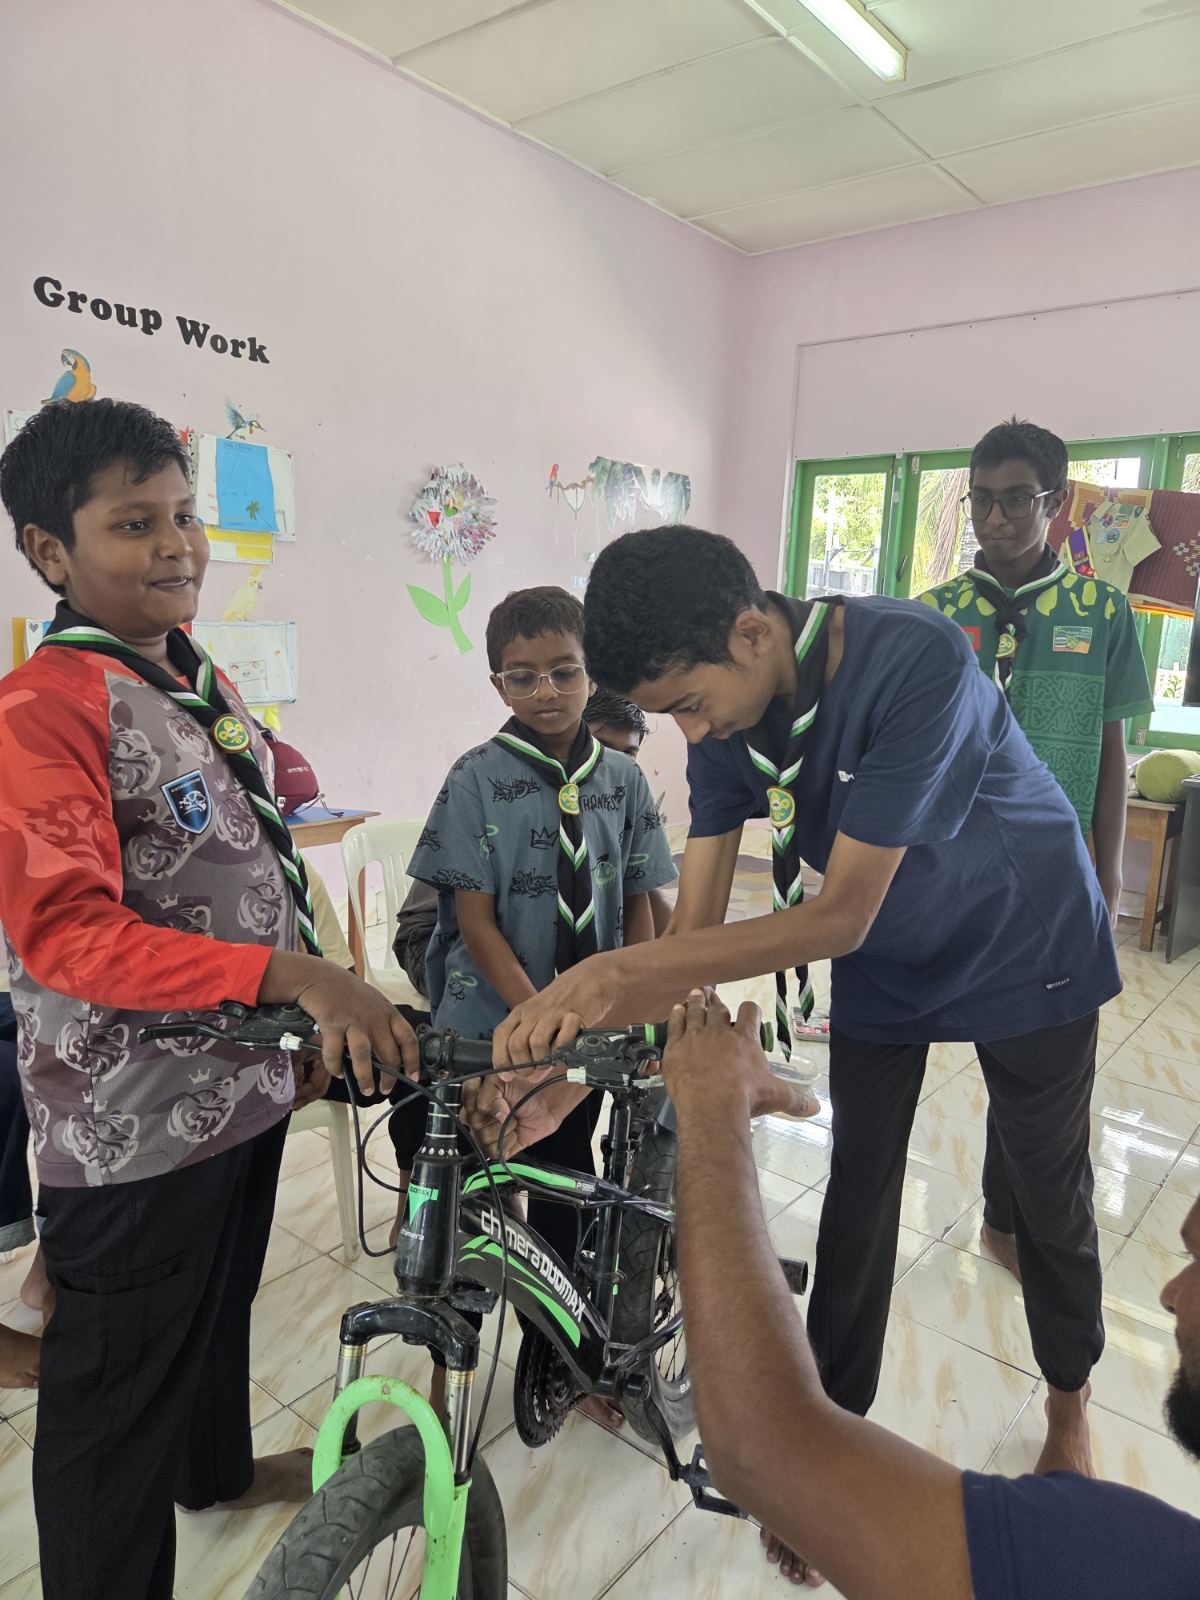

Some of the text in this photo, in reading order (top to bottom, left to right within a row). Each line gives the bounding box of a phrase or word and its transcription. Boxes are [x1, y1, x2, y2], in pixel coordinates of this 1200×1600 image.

[33, 276, 270, 364] Group Work
[481, 1208, 541, 1270] chmera
